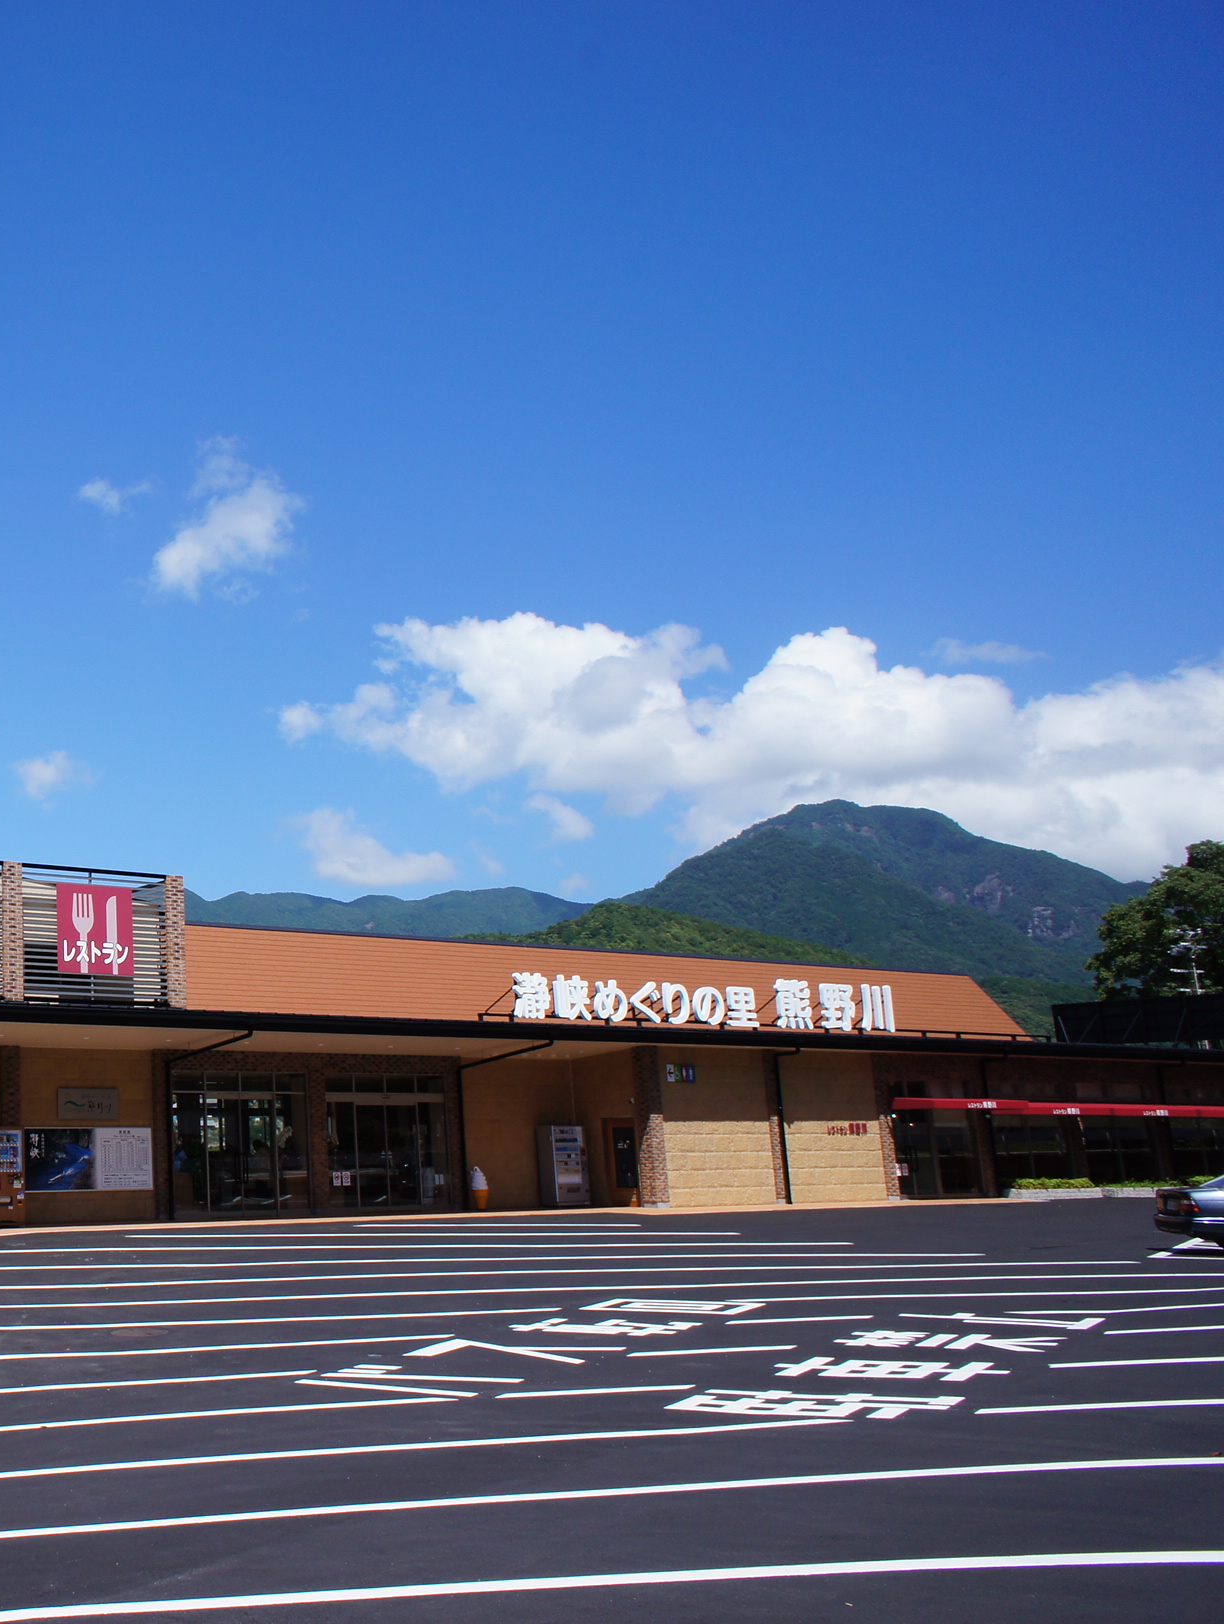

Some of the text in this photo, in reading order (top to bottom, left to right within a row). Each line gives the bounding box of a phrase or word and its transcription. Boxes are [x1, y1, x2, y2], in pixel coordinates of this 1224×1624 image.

[63, 939, 129, 964] レストラン
[512, 972, 896, 1033] 瀞峡めぐりの里 熊野川
